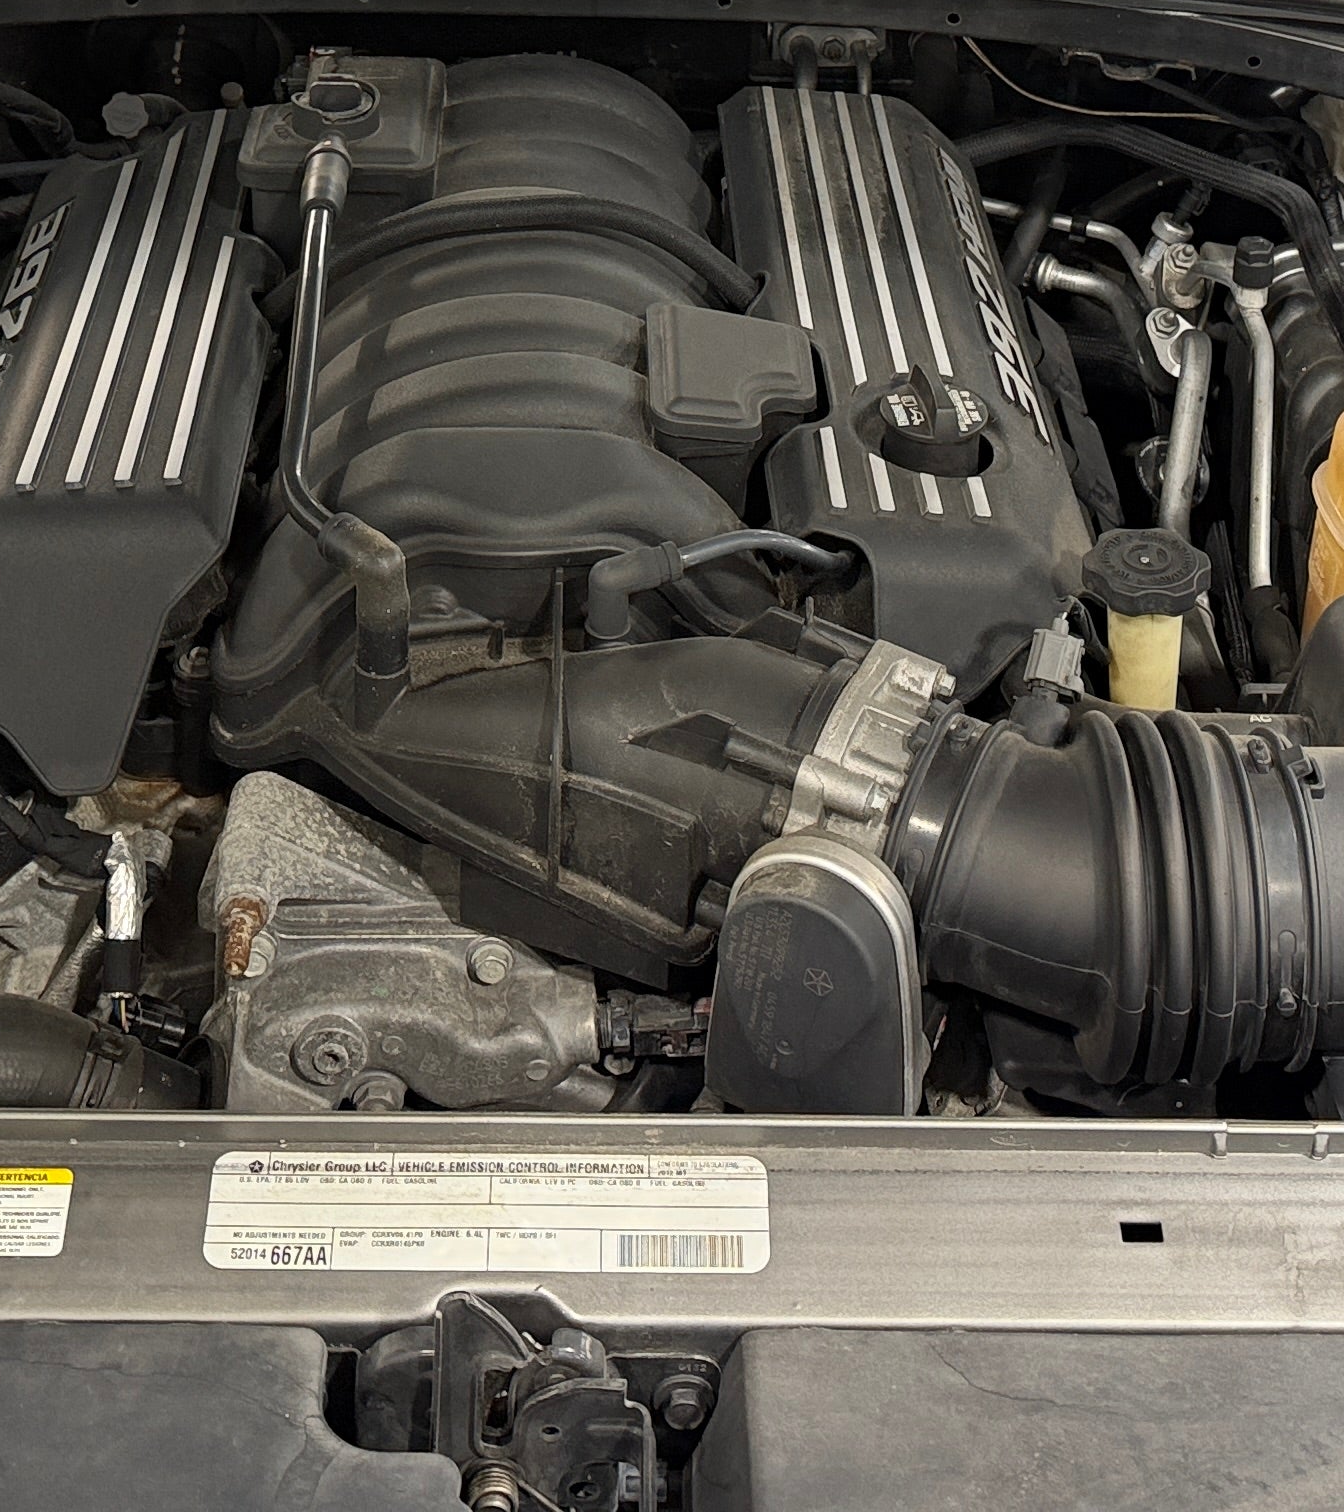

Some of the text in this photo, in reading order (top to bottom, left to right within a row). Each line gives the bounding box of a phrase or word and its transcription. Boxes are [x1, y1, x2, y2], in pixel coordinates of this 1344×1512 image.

[964, 254, 1051, 447] 392
[1249, 714, 1273, 723] AC
[272, 1160, 387, 1175] Chrysler Group LLC
[399, 1161, 644, 1175] VEHICLE EMISSION CONTROL INFORMATION
[245, 1231, 296, 1239] ADJUSTMENTS
[230, 1245, 327, 1266] 52014 667AA
